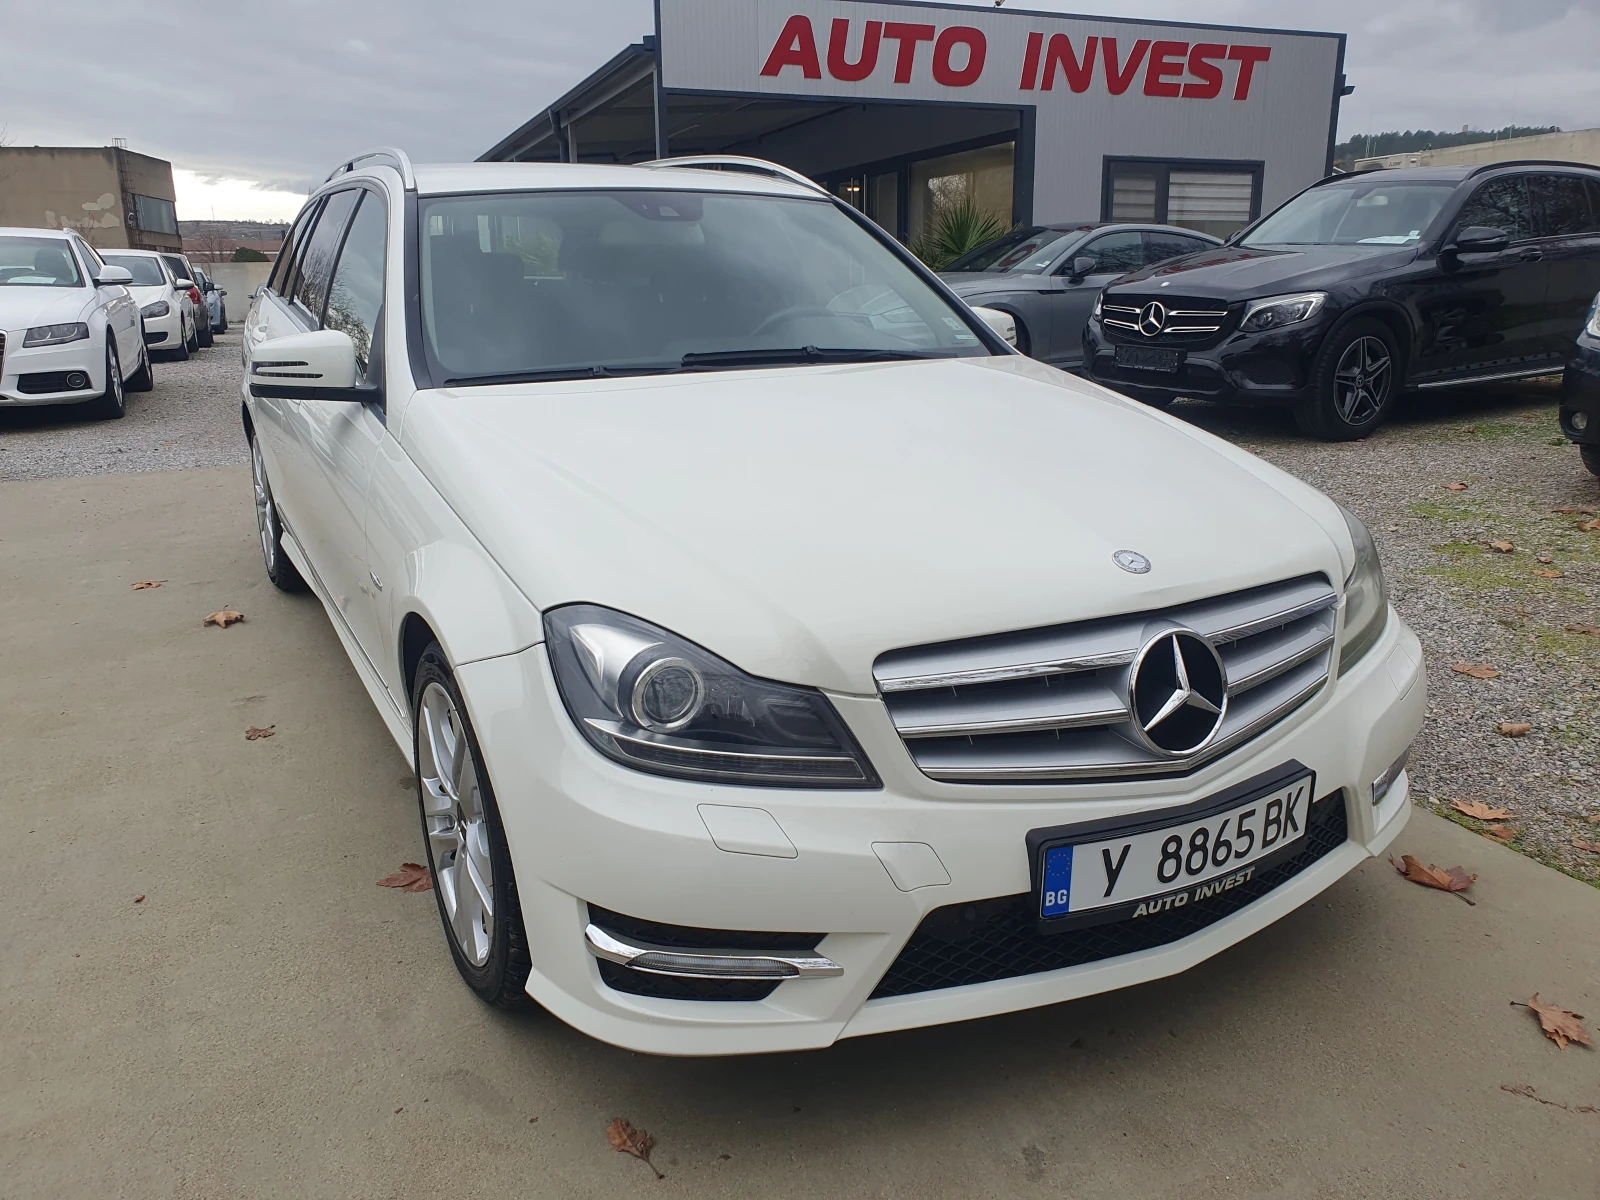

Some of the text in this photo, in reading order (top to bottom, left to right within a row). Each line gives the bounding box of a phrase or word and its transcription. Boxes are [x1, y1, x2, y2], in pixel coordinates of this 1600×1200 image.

[759, 14, 1272, 100] AUTO INVEST
[1045, 889, 1067, 906] BG
[1132, 866, 1256, 918] AUTO INVEST
